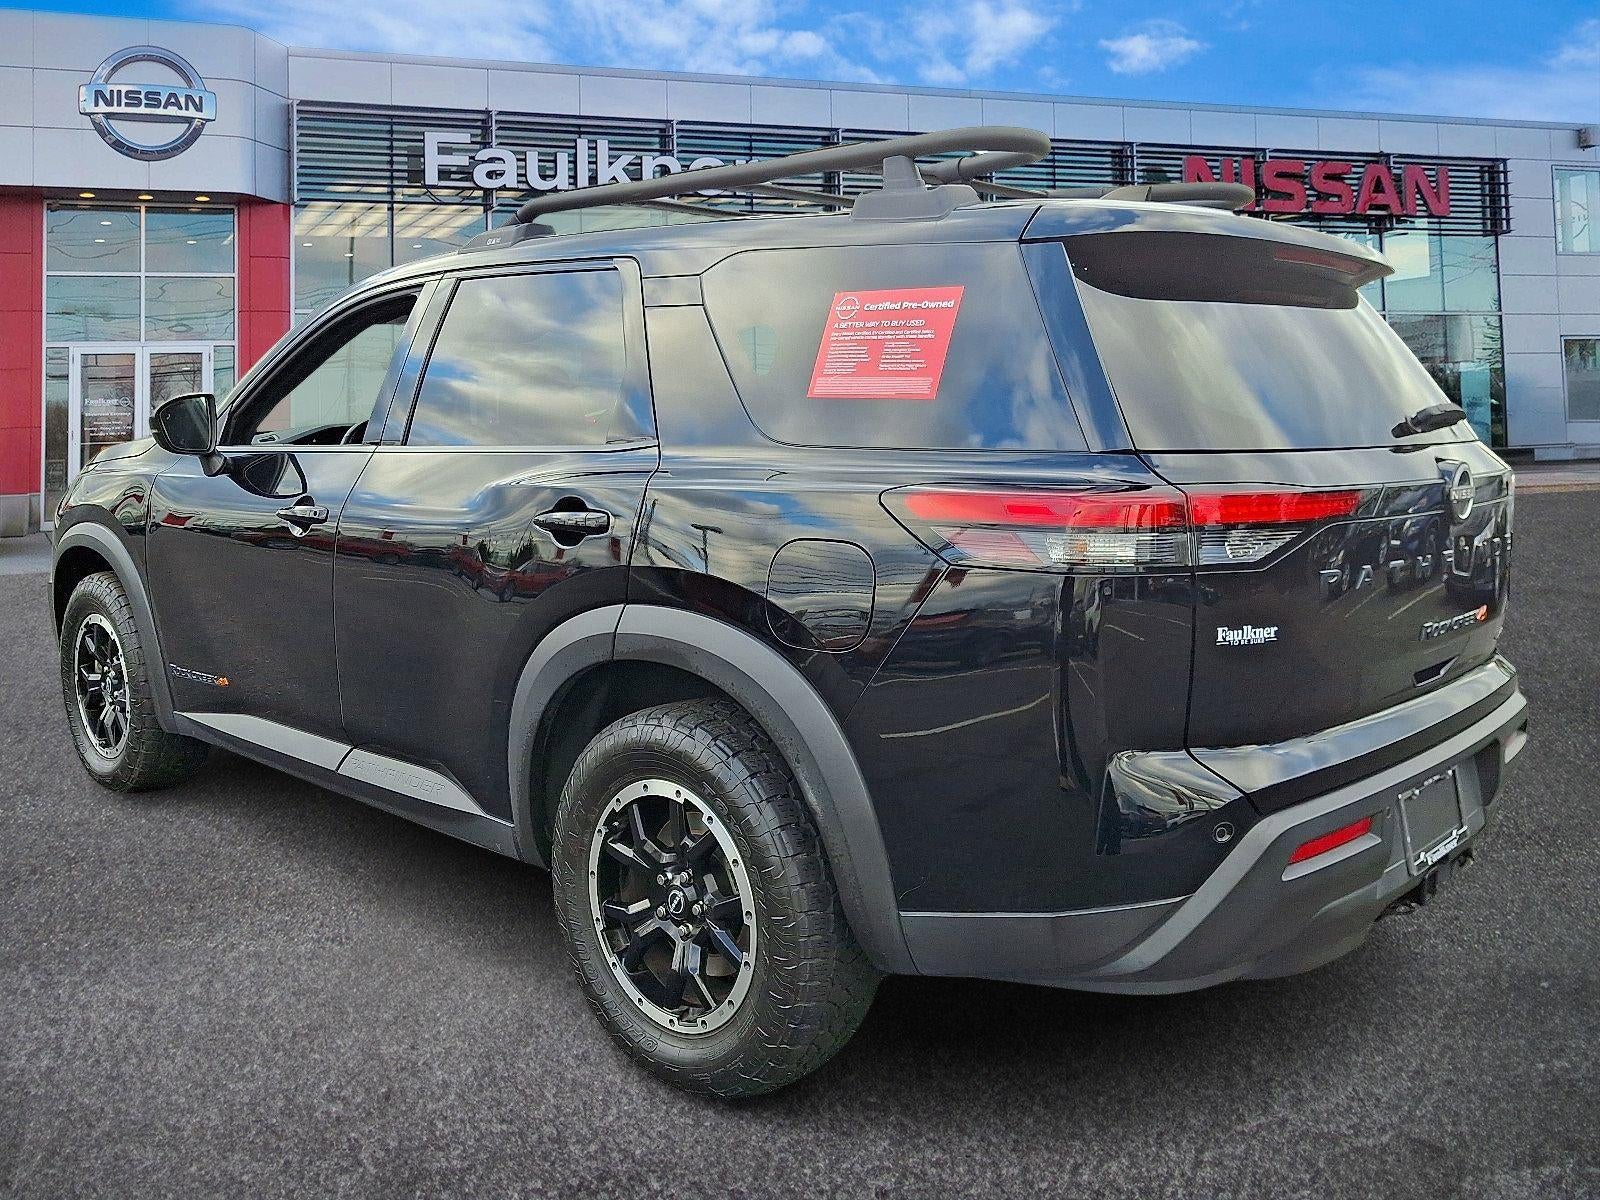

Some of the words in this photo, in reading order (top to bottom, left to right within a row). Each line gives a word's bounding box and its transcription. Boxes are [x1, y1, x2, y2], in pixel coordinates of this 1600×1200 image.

[94, 89, 203, 113] NISSAN
[423, 131, 759, 197] Faulkn
[1184, 155, 1451, 217] NISSAN
[863, 300, 900, 311] Certified
[901, 299, 955, 310] Pre-Owned
[839, 321, 864, 329] BETTER
[906, 319, 925, 327] USED
[1216, 625, 1278, 642] Faulkner
[349, 757, 447, 797] PATHFINDER
